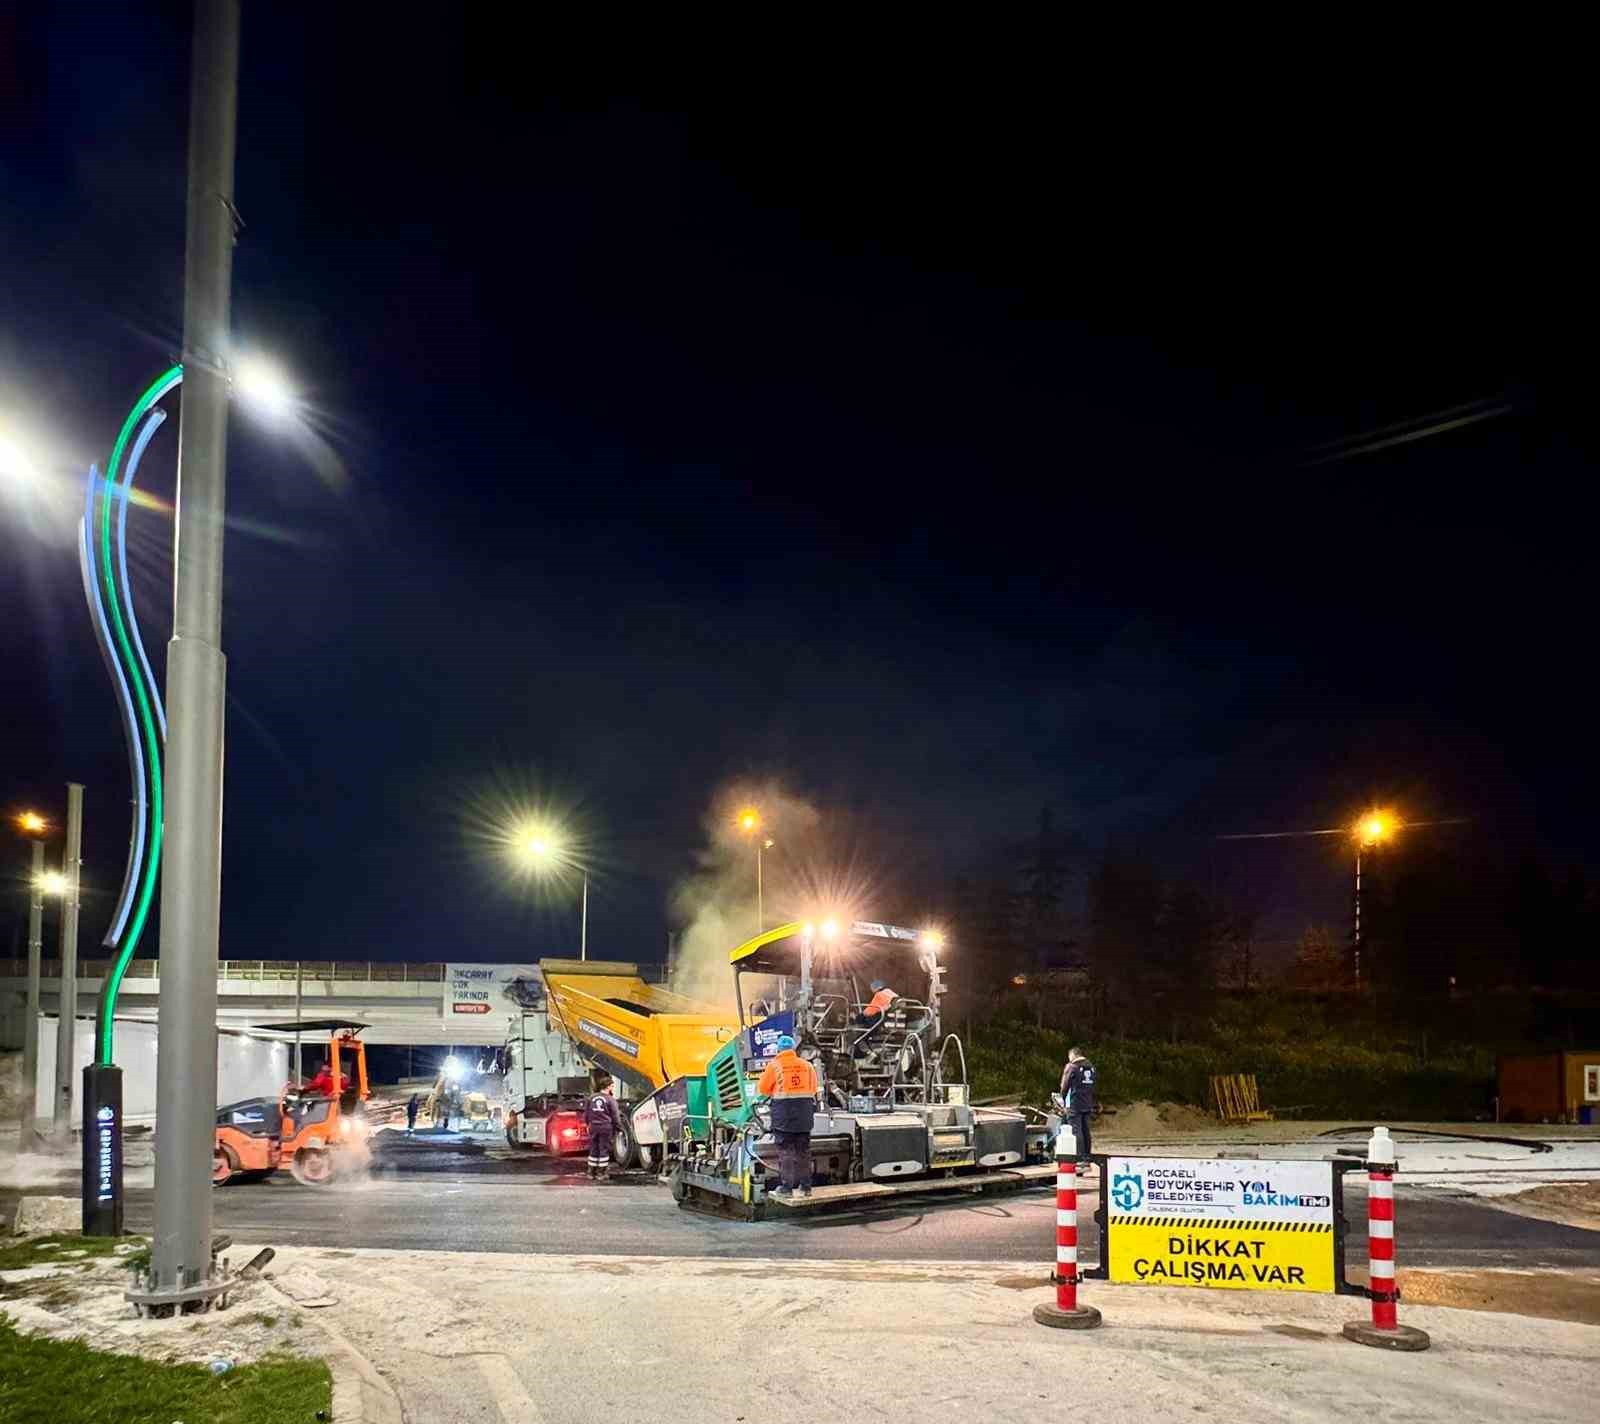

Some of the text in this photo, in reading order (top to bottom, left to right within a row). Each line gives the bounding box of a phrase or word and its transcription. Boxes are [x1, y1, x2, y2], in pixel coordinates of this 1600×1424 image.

[1239, 1180, 1277, 1194] YOL
[1243, 1193, 1299, 1207] BAKIM
[1168, 1234, 1266, 1259] DİKKAT
[1133, 1258, 1306, 1285] ÇALIŞMA VAR
